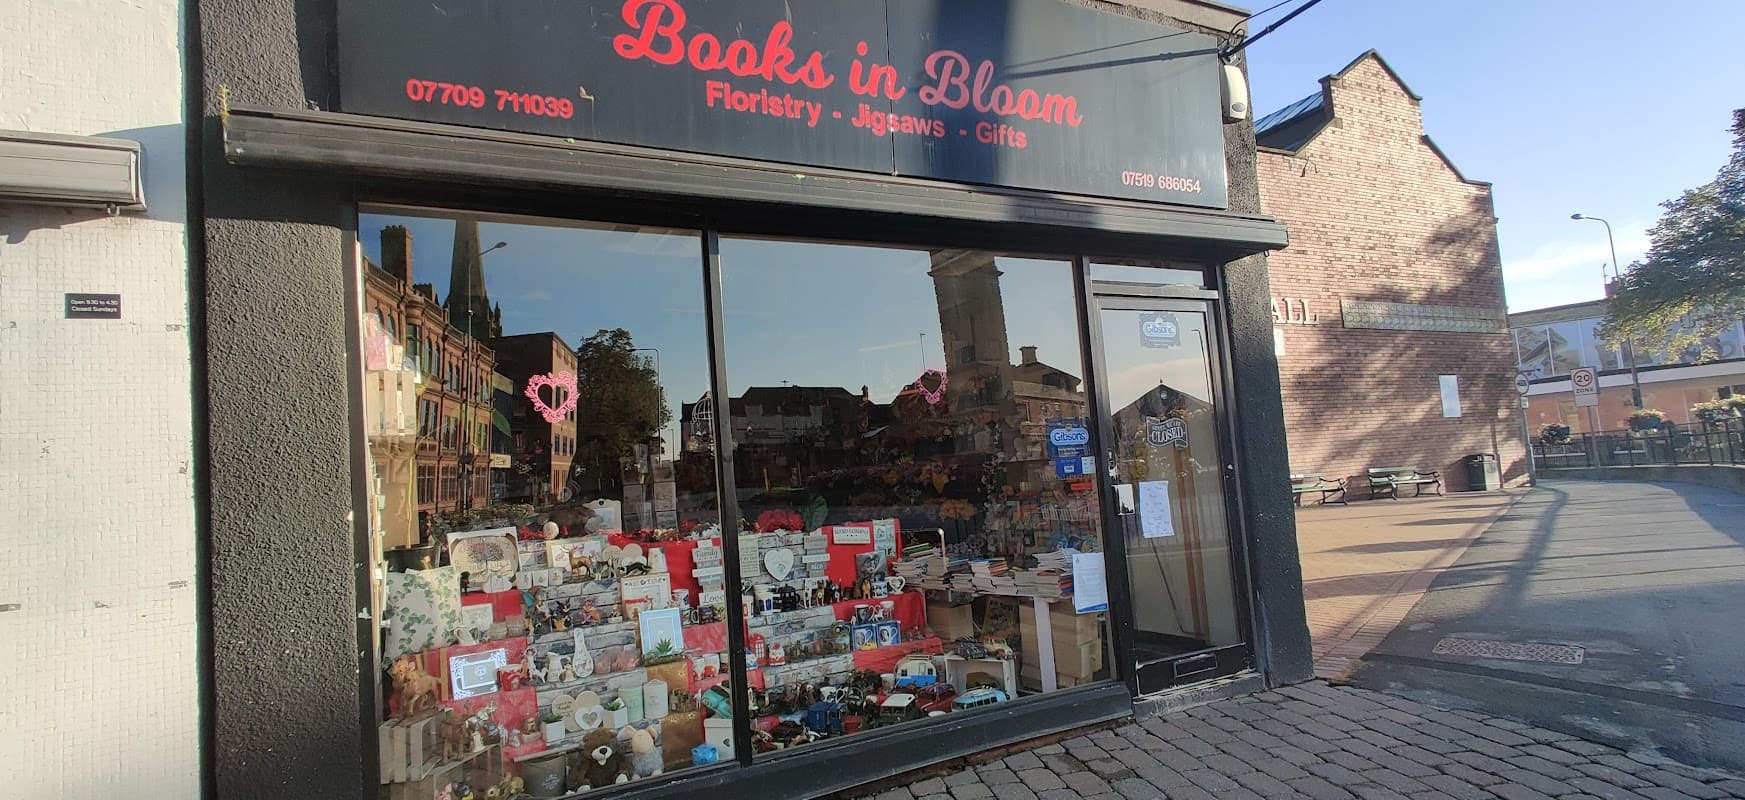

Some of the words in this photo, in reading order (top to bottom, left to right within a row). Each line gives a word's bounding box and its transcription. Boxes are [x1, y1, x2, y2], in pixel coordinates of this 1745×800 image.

[613, 0, 835, 90] Books
[849, 42, 906, 101] in
[919, 50, 1083, 127] Bloom
[406, 78, 485, 109] 07709
[495, 89, 575, 120] 711039
[706, 80, 822, 128] Floristry
[851, 103, 945, 137] Jigsaws
[975, 122, 1028, 149] Gifts
[1122, 170, 1155, 188] 07519
[1158, 175, 1201, 193] 686054
[1576, 374, 1591, 383] 20
[1054, 432, 1086, 442] Gibsons
[1151, 426, 1184, 442] CLOSED
